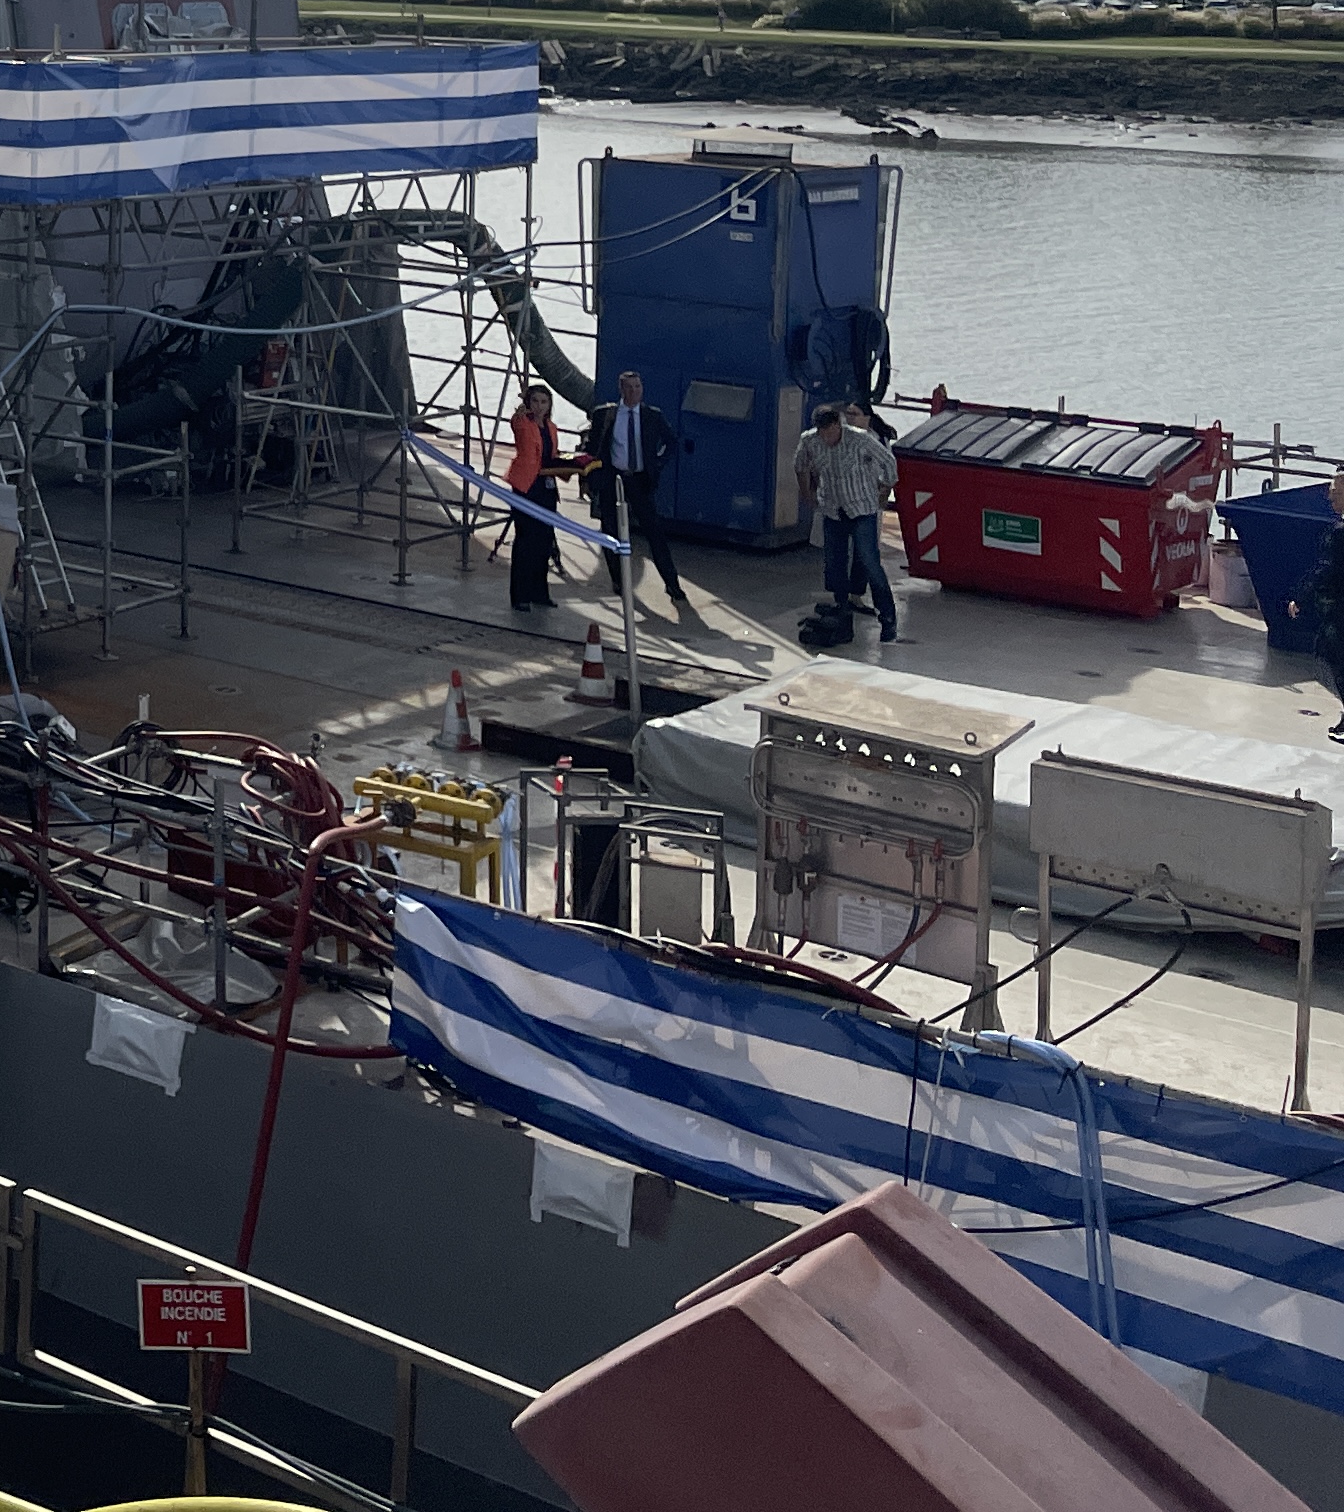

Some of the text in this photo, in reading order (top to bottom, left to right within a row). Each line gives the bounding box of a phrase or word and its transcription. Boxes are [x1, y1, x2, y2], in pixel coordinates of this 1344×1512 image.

[162, 1288, 223, 1304] BOUCHE
[160, 1306, 226, 1322] INCENDIE
[205, 1331, 212, 1345] 1
